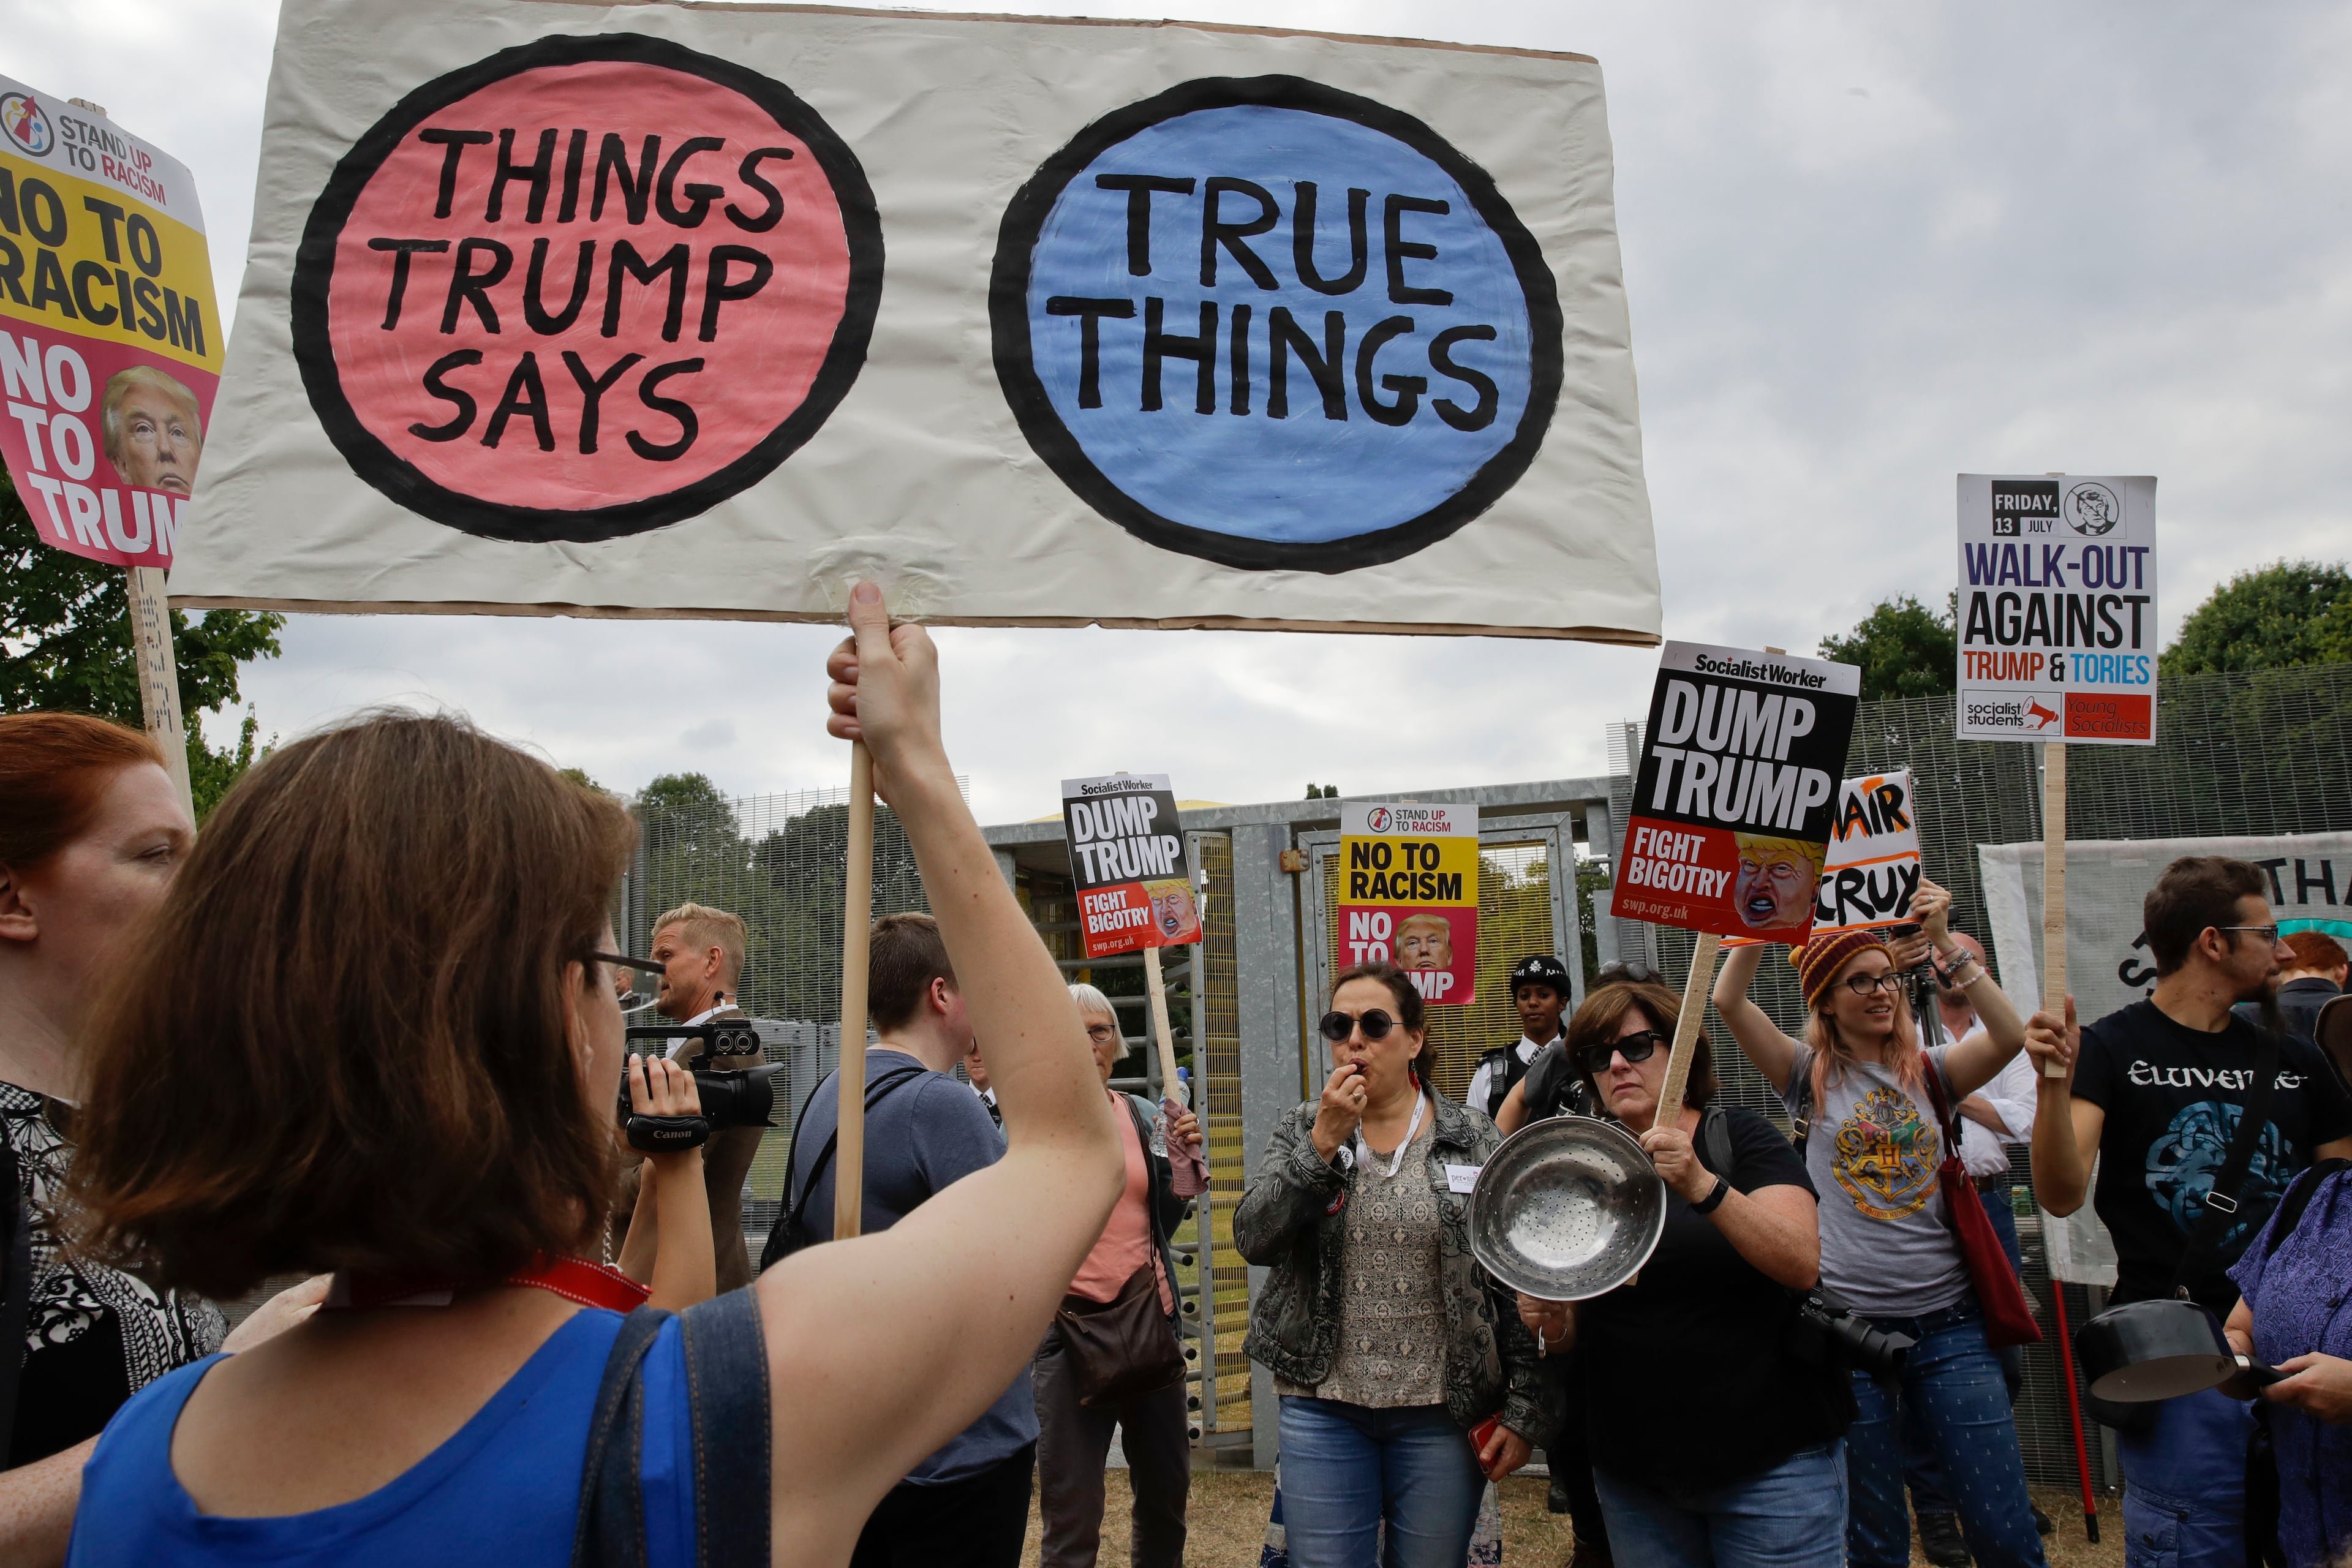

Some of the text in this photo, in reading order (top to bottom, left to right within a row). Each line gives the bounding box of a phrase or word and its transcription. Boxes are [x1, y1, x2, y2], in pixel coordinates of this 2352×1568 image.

[61, 114, 152, 173] STAND UP
[62, 140, 167, 206] TO RACISM
[419, 129, 794, 233] THINGS
[83, 195, 162, 279] TO
[1096, 174, 1454, 306] TRUE
[0, 235, 206, 358] RACISM
[368, 237, 774, 343] TRUMP
[1, 331, 92, 413] NO
[1046, 296, 1499, 432] THINGS
[408, 350, 704, 462] SAYS
[8, 401, 96, 481] TO
[1995, 494, 2058, 513] FRIDAY,
[1995, 517, 2052, 533] 13 JULY
[1964, 543, 2149, 589] WALK-OUT
[1964, 591, 2150, 649] AGAINST
[1694, 654, 1826, 689] Socialist Worker
[1962, 651, 2150, 685] TRUMP & TORIES
[1657, 679, 1816, 761] DUMP
[1967, 702, 2021, 717] socialist
[1967, 712, 2024, 726] students
[2067, 697, 2117, 719] Young
[2071, 715, 2147, 734] Socialists
[1081, 780, 1153, 795] Socialist Worker
[1651, 745, 1831, 832] TRUMP
[1071, 796, 1158, 843] DUMP
[1396, 810, 1446, 820] STAND UP
[1396, 821, 1450, 832] TO RACISM
[1075, 835, 1180, 884] TRUMP
[1351, 842, 1440, 871] NO TO
[1633, 826, 1706, 864] FIGHT
[1350, 872, 1461, 900] RACISM
[1627, 856, 1731, 899] BIGOTRY
[1084, 890, 1127, 914] FIGHT
[1622, 897, 1689, 920] swp.org.uk
[1087, 906, 1150, 934] BIGOTRY
[1349, 911, 1392, 941] NO
[1092, 935, 1134, 952] swp.org.uk
[1349, 941, 1389, 967] TO
[653, 1129, 692, 1139] Canon
[1881, 1148, 1897, 1165] H
